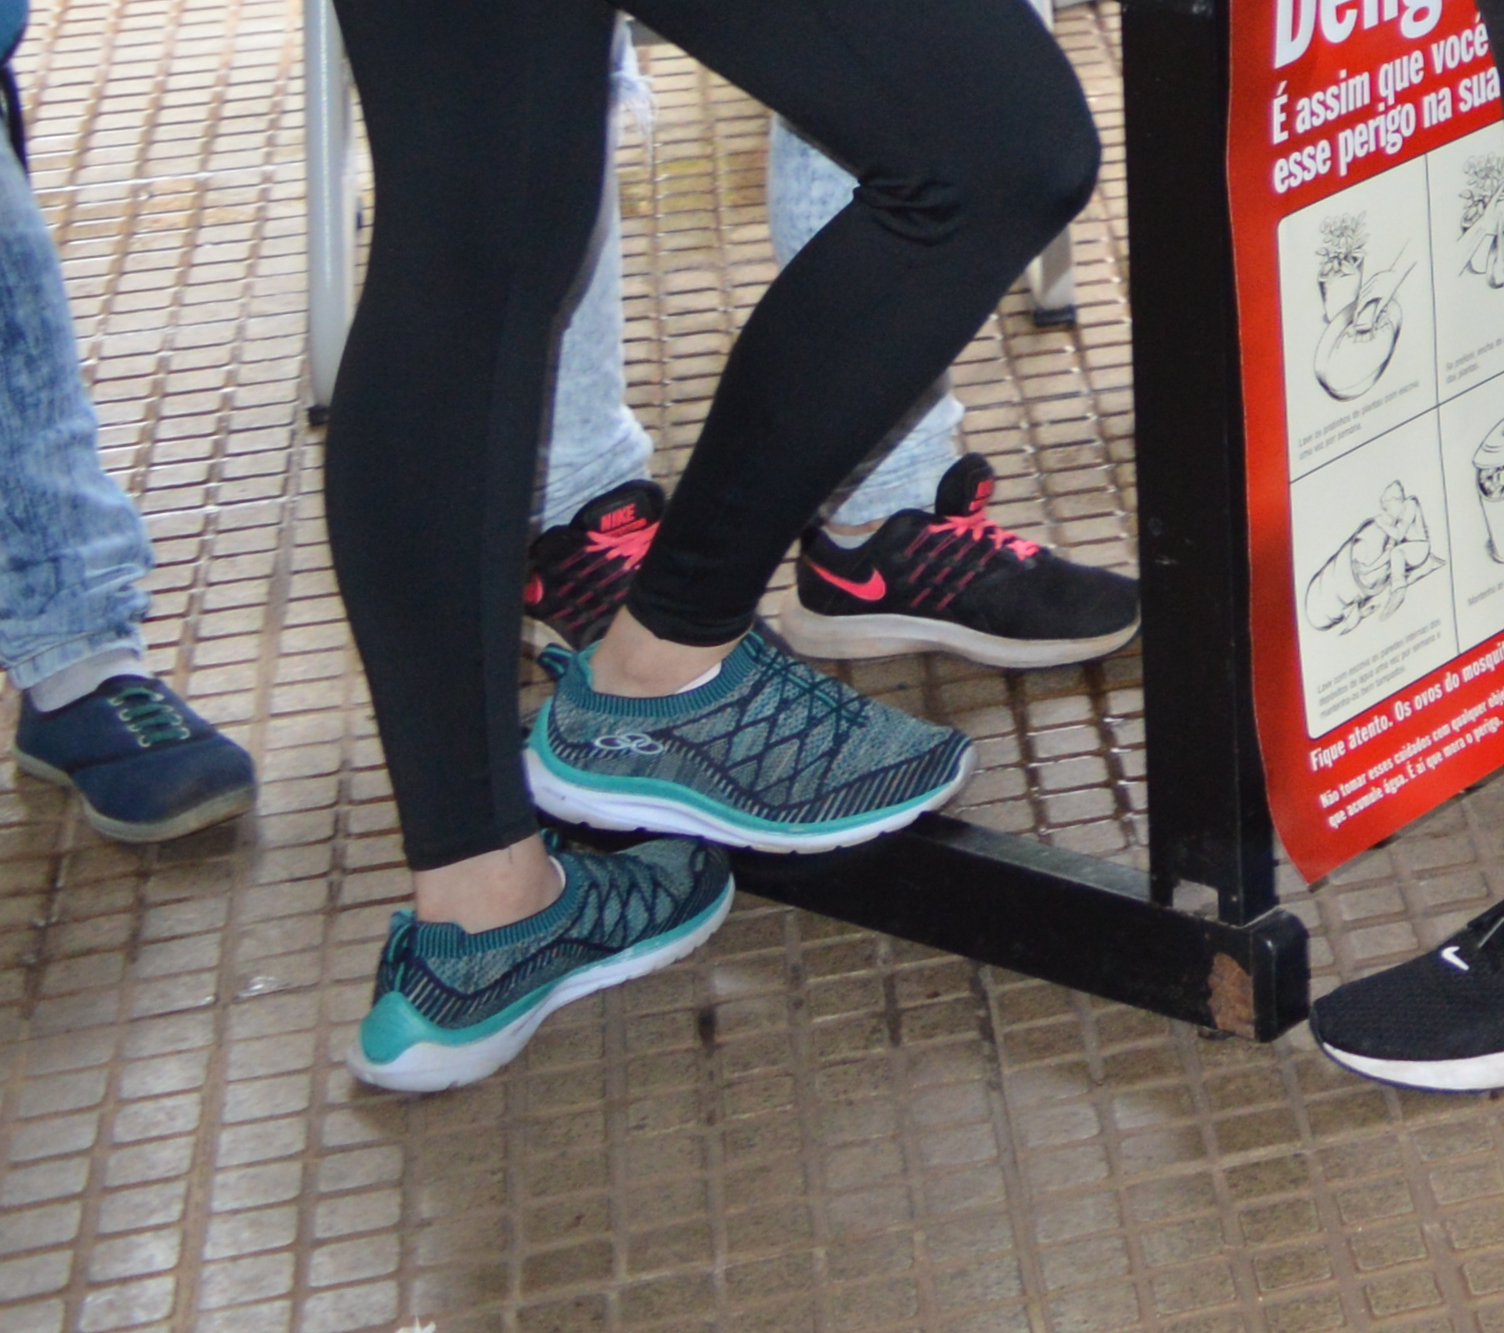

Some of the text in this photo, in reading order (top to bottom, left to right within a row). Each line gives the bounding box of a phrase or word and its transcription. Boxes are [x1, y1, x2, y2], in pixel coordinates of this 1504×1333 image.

[1273, 13, 1489, 145] É assim que você
[1273, 66, 1500, 194] esse perigo na sua
[601, 504, 636, 531] NIKE
[1310, 740, 1346, 772] Fique
[1348, 715, 1394, 750] atento.
[1394, 700, 1412, 721] Os
[1414, 683, 1442, 710] ovos
[1444, 672, 1460, 693] do
[1319, 790, 1340, 809] Não
[1339, 773, 1367, 797] tomar
[1367, 758, 1394, 780] esses
[1394, 736, 1432, 764] cuidados
[1432, 724, 1451, 742] com
[1450, 701, 1487, 732] qualquer
[1328, 716, 1504, 829] que acumule água. É aí que mora o perigo.
